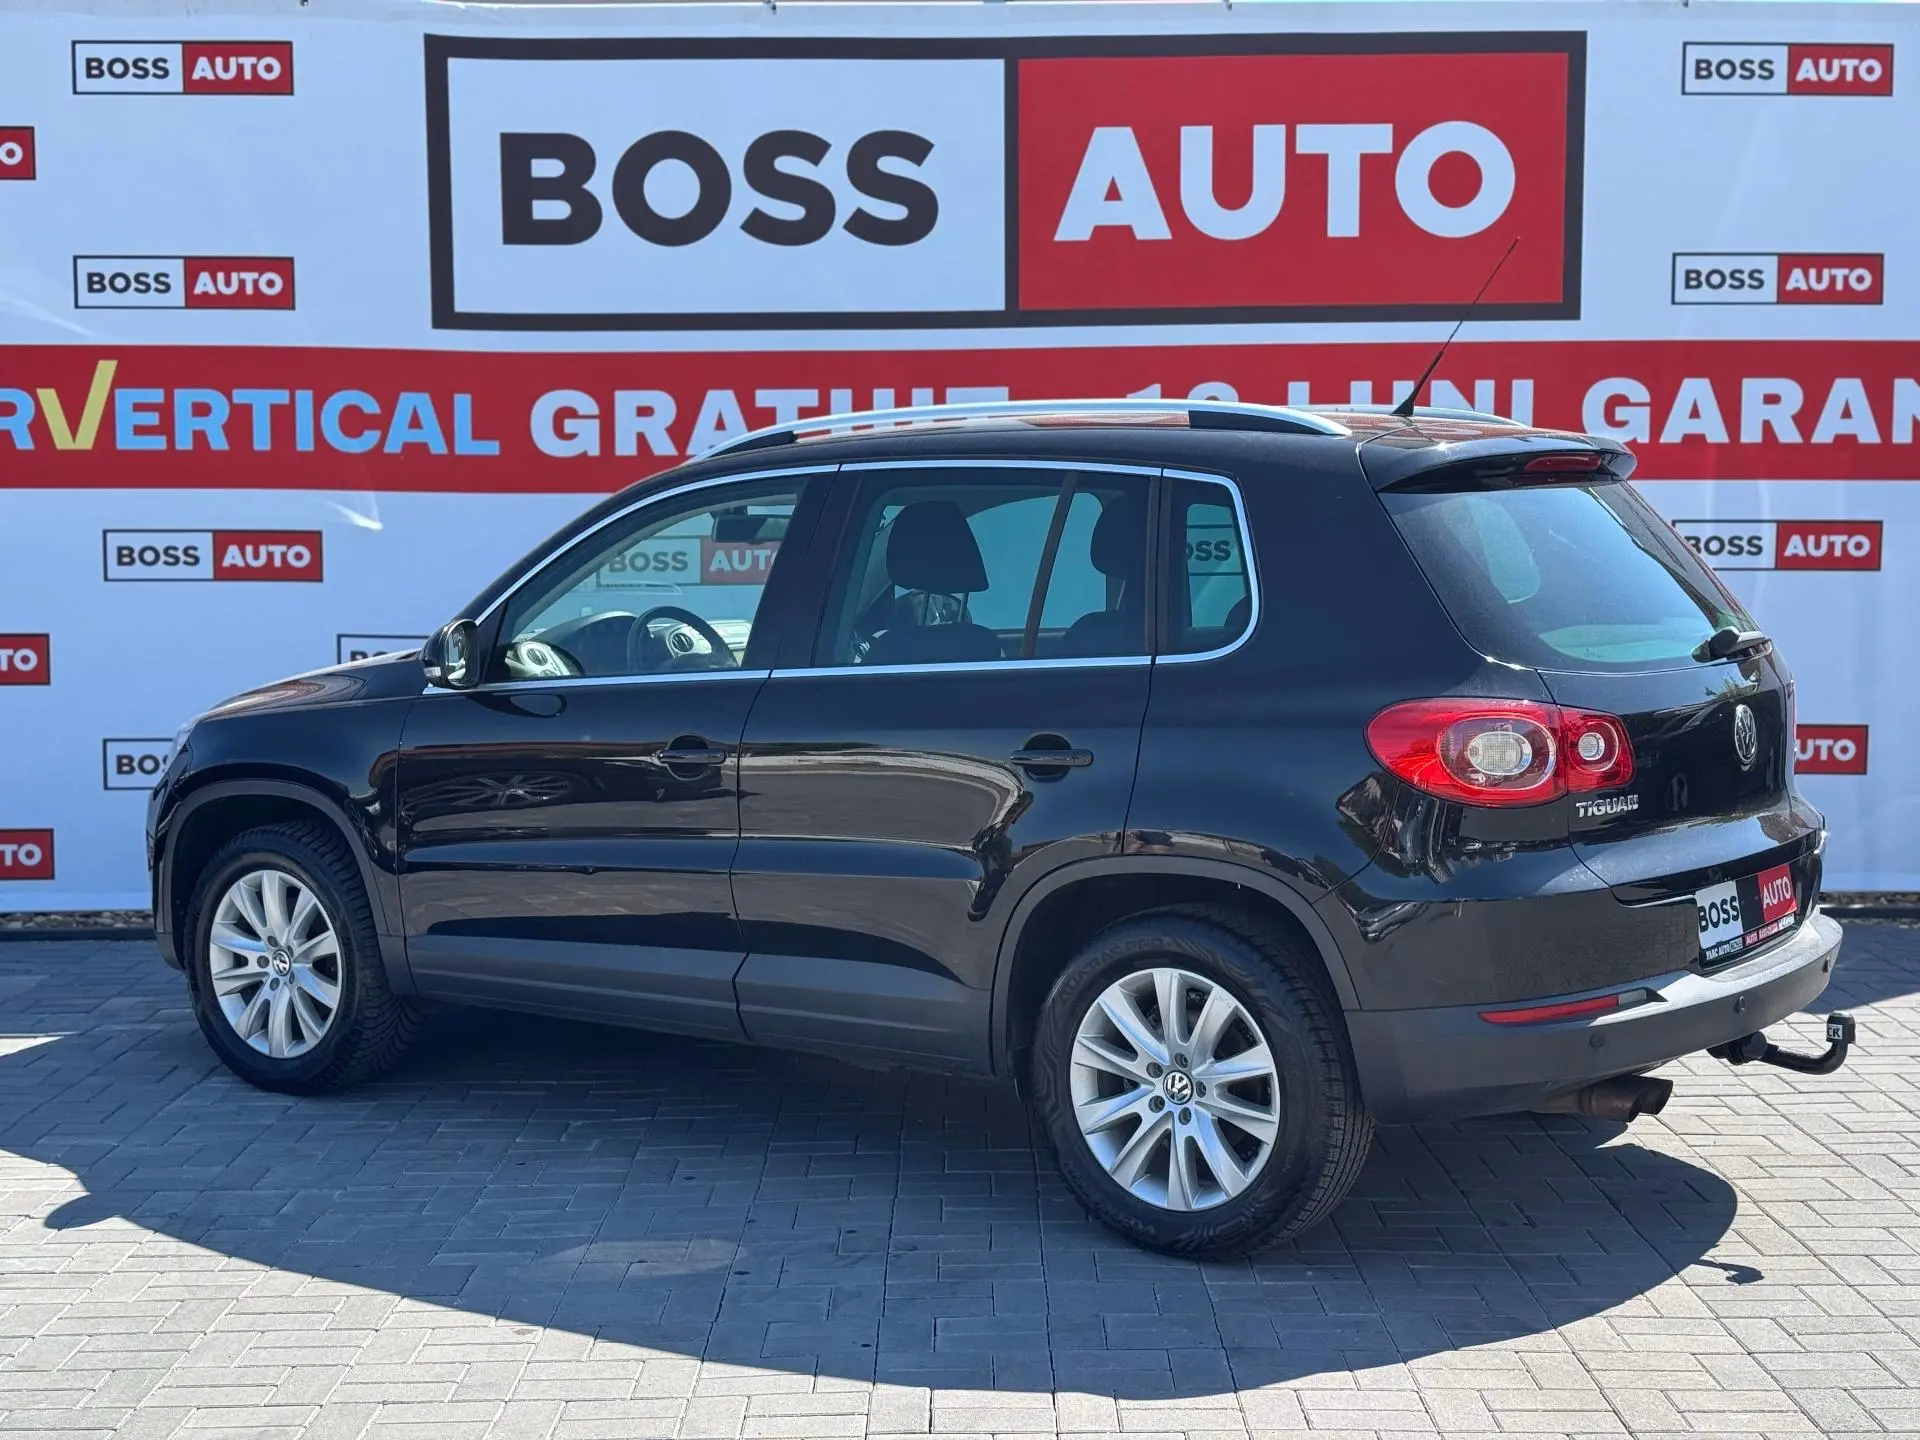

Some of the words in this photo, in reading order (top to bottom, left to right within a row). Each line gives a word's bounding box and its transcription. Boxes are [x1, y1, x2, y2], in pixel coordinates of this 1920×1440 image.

[85, 57, 170, 80] BOSS
[192, 56, 281, 81] AUTO
[1694, 58, 1775, 81] BOSS
[1796, 58, 1883, 82] AUTO
[500, 130, 939, 247] BOSS
[1053, 120, 1516, 242] AUTO
[86, 271, 171, 294] BOSS
[194, 271, 283, 296] AUTO
[1684, 268, 1765, 290] BOSS
[1786, 267, 1873, 291] AUTO
[116, 545, 200, 567] BOSS
[222, 544, 311, 568] AUTO
[1784, 534, 1871, 557] AUTO
[608, 550, 689, 573] BOSS
[709, 549, 778, 572] AUT
[116, 754, 168, 775] BO
[1575, 794, 1639, 818] TIGUAN
[1697, 895, 1741, 933] BOSS
[1762, 876, 1791, 909] AUTO
